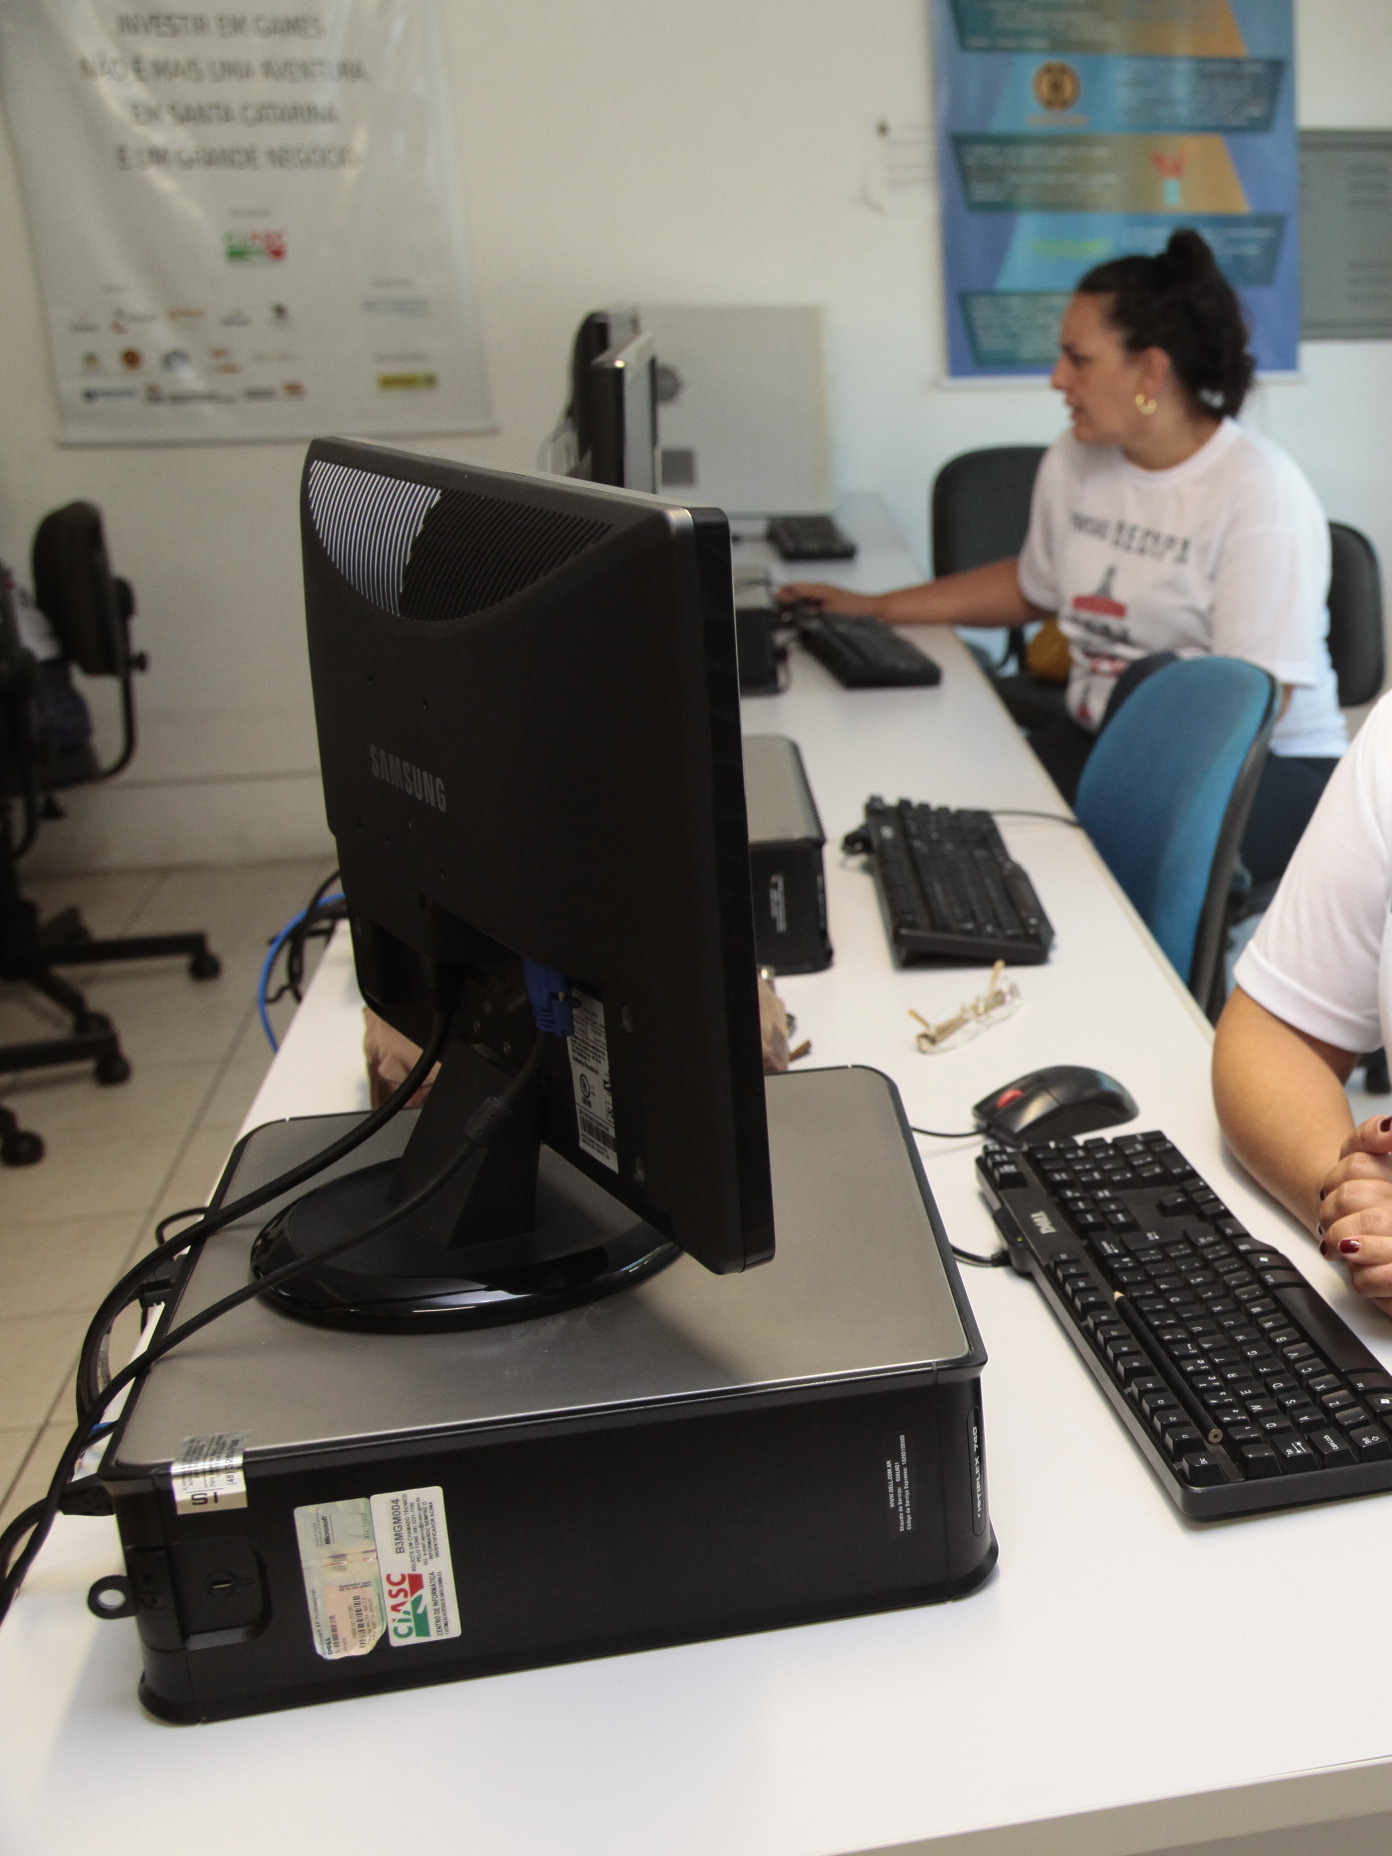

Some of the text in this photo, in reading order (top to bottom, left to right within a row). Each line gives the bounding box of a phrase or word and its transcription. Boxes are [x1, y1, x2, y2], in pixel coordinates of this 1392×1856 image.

[116, 13, 326, 39] INVESTIR EM GAMES
[151, 59, 205, 82] MAIS
[210, 60, 252, 82] UMA
[166, 101, 234, 125] SANTA
[241, 102, 338, 126] CATARINA
[177, 147, 257, 170] GRANDE
[369, 743, 447, 813] SAMSUNG
[322, 1516, 330, 1545] Microsoft
[391, 1499, 404, 1553] B3MGM004
[433, 1607, 440, 1615] DE
[434, 1616, 443, 1636] CENTRO
